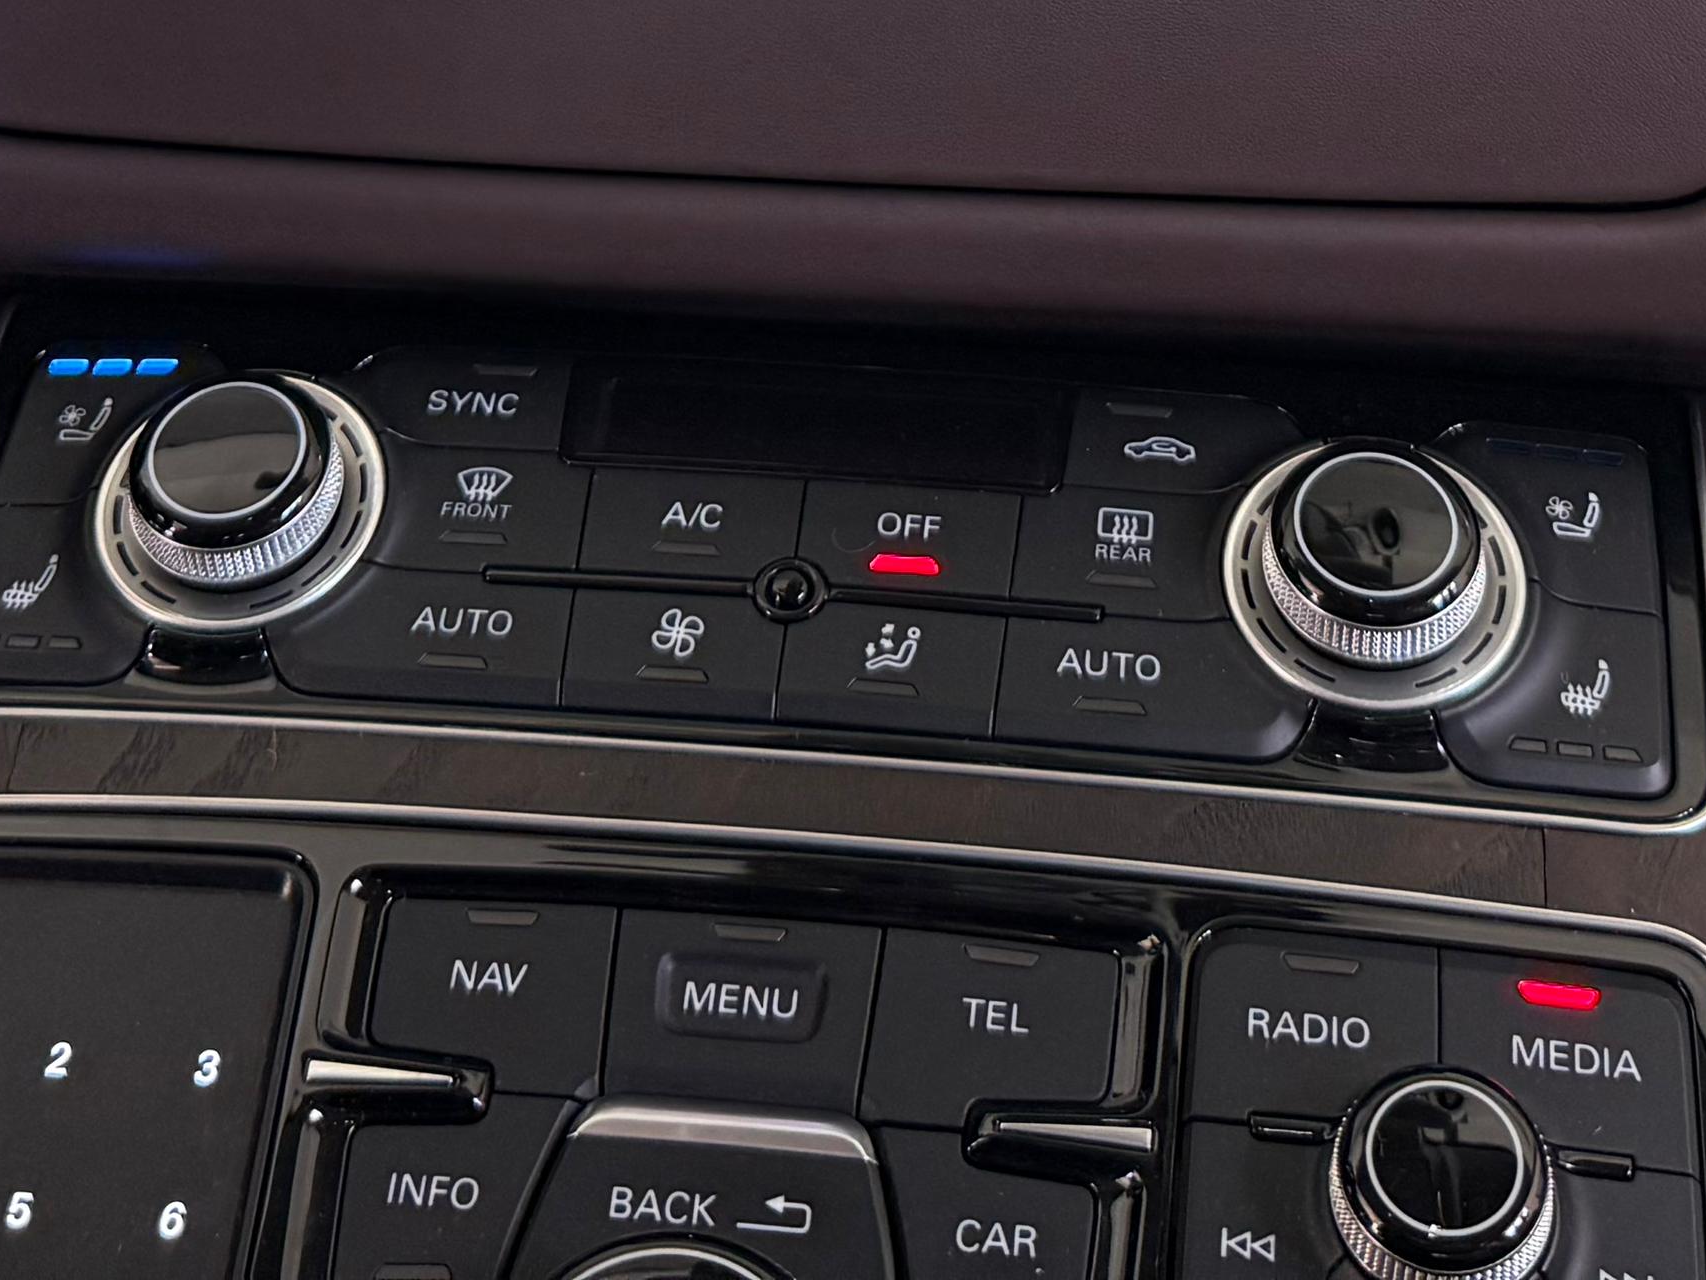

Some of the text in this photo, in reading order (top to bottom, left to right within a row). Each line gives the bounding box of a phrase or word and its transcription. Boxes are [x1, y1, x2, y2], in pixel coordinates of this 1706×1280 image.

[426, 388, 520, 419] SYNC
[440, 500, 513, 523] FRONT
[660, 501, 725, 532] A/C
[876, 512, 943, 540] OFF
[1094, 542, 1152, 565] REAR
[410, 605, 515, 638] AUTO
[1055, 647, 1162, 682] AUTO
[449, 958, 530, 996] NAV
[682, 979, 800, 1020] MENU
[962, 996, 1030, 1035] TEL
[1247, 1007, 1372, 1049] RADIO
[44, 1041, 74, 1079] 2
[193, 1048, 222, 1088] 3
[1510, 1034, 1643, 1083] MEDIA
[4, 1191, 35, 1231] 5
[386, 1172, 481, 1212] INFO
[608, 1186, 718, 1228] BACK
[157, 1200, 188, 1242] 6
[954, 1218, 1038, 1259] CAR
